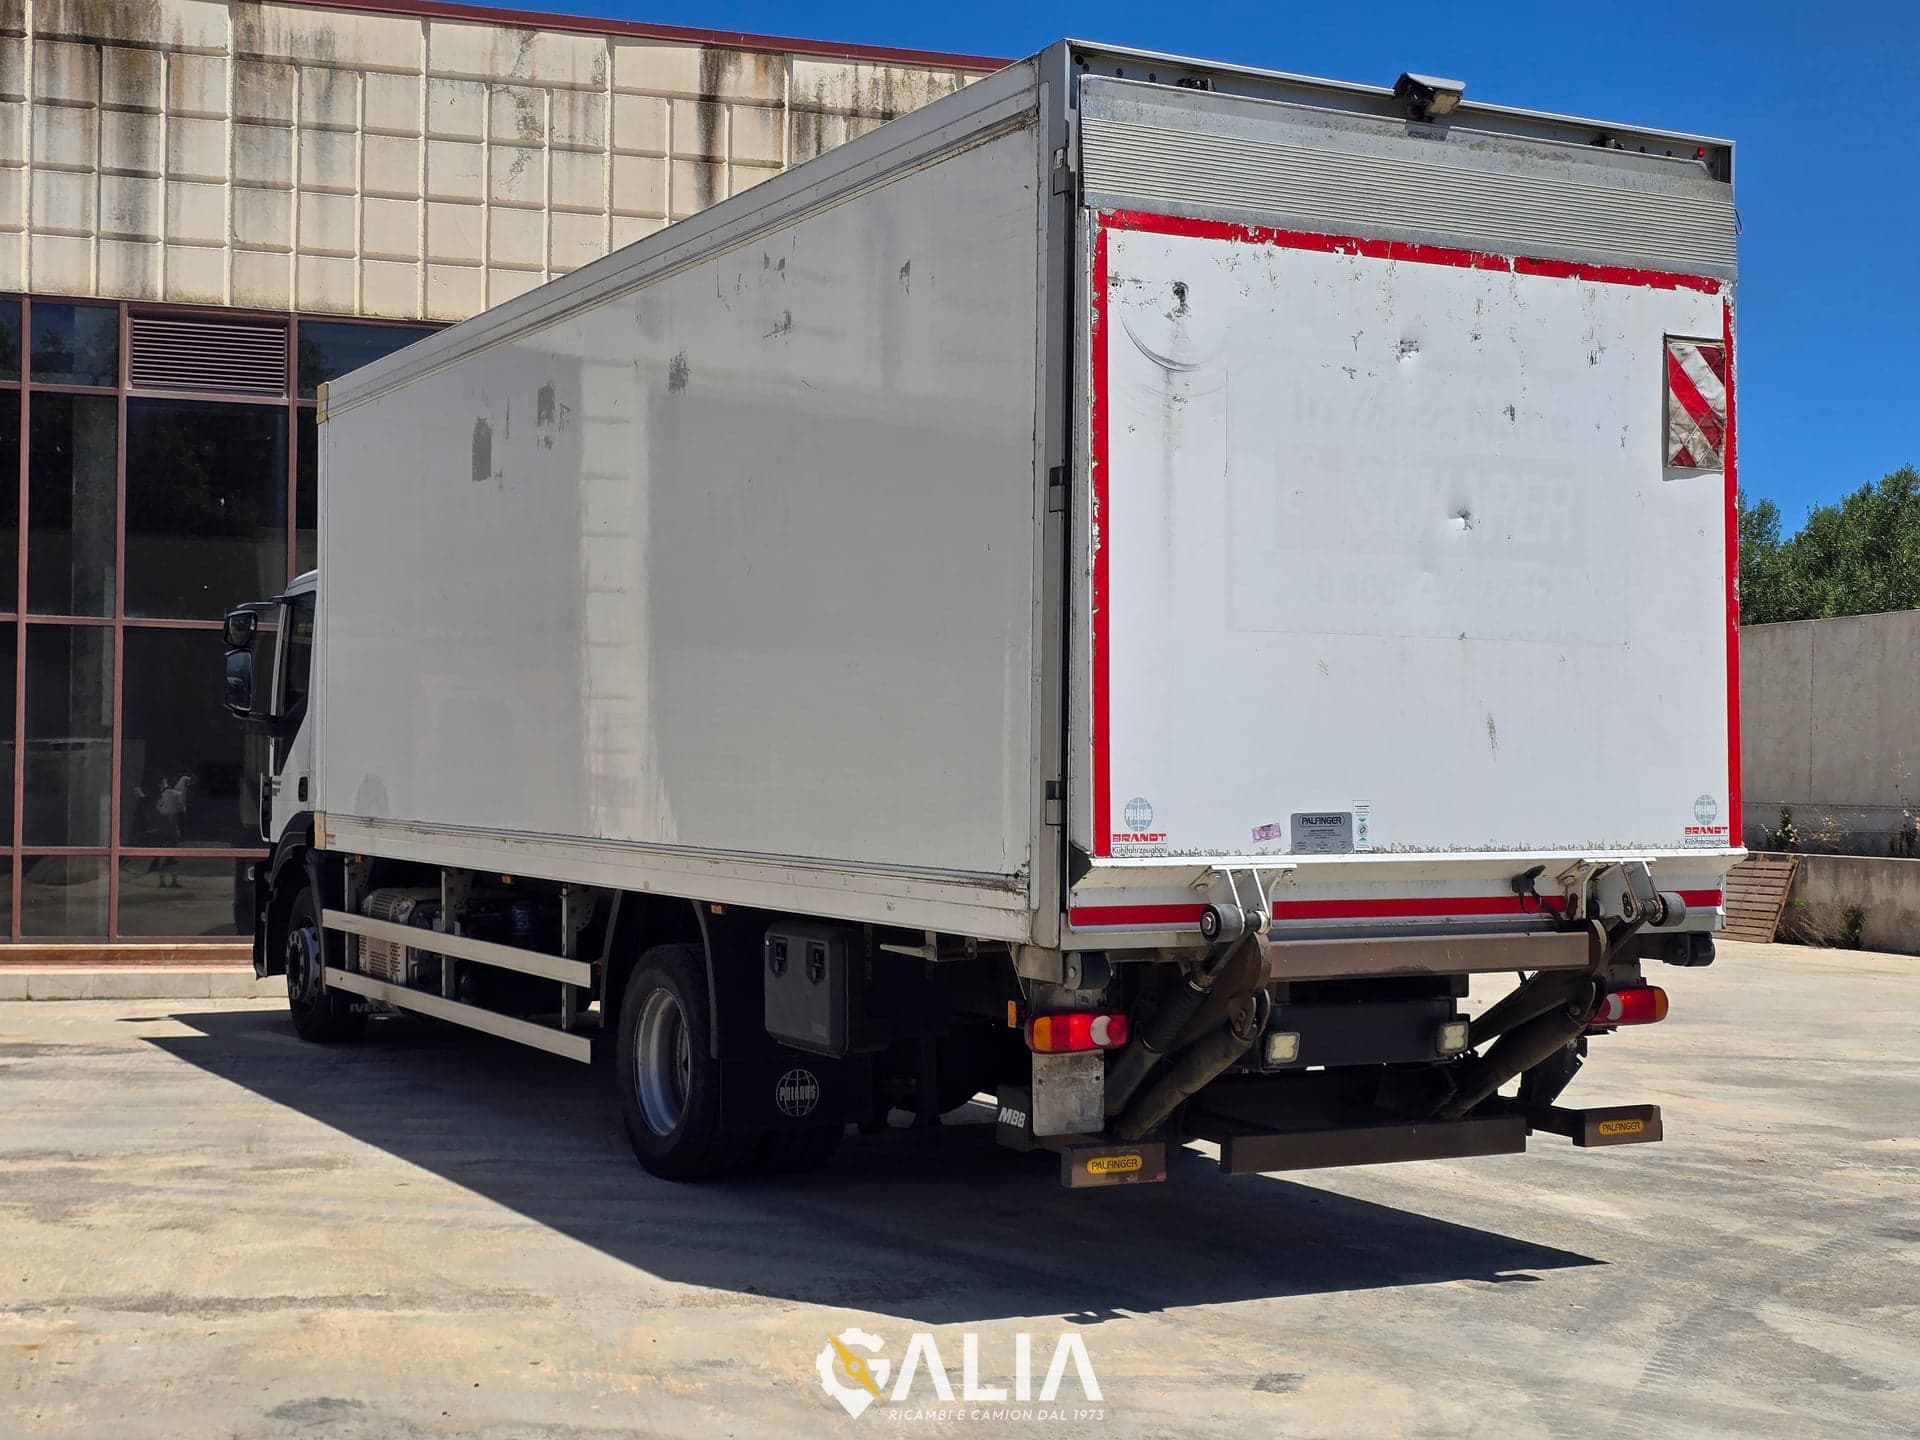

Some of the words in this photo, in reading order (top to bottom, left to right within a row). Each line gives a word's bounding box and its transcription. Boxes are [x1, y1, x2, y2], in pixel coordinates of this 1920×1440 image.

[1302, 816, 1342, 825] PALFINGER
[1685, 826, 1728, 835] BRANDT
[1112, 833, 1167, 842] BRANDT
[998, 1107, 1026, 1128] MBB
[1603, 1121, 1640, 1133] PALFINGER
[1091, 1157, 1138, 1170] PALFINGER
